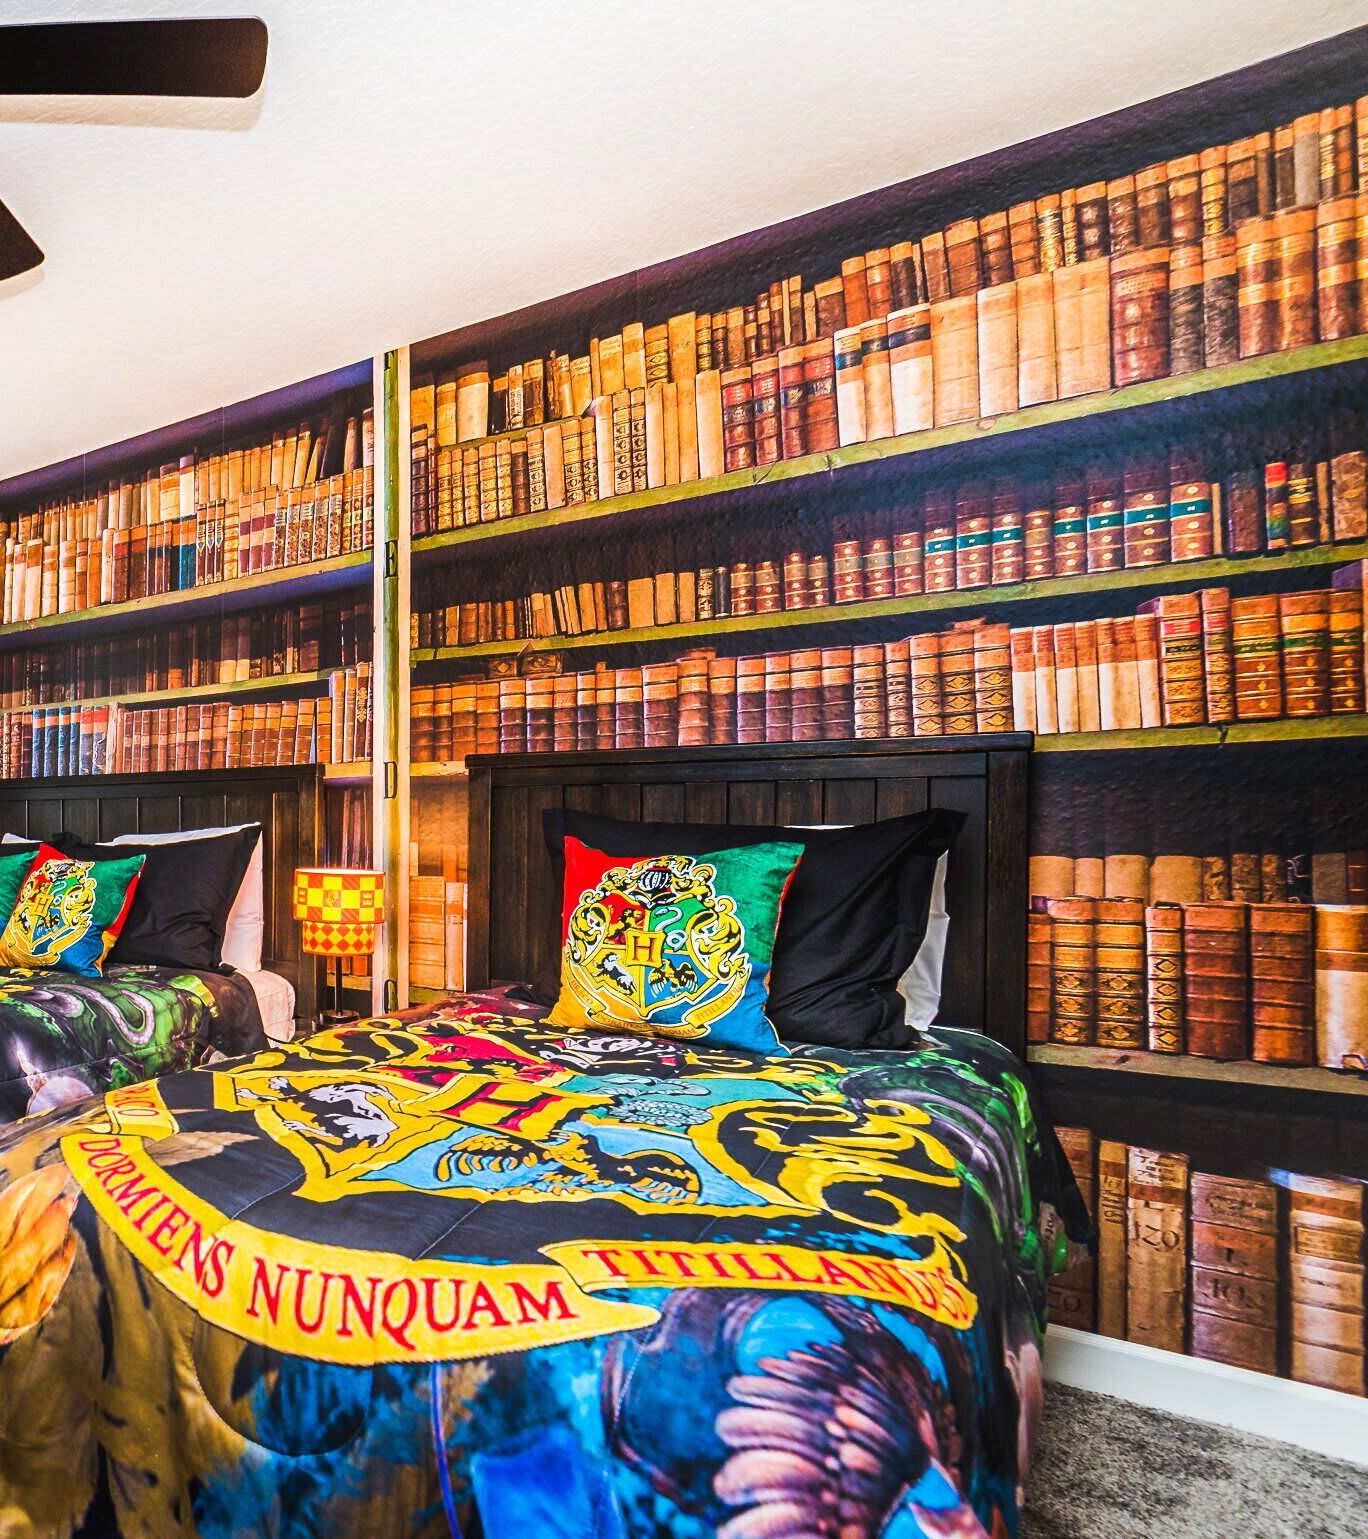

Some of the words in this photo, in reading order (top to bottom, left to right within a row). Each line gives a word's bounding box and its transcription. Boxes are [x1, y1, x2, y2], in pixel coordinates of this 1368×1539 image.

[385, 540, 398, 578] E
[384, 761, 399, 799] D
[632, 935, 657, 962] H
[436, 1082, 562, 1132] H
[79, 1137, 237, 1298] DORMIENS
[247, 1256, 580, 1353] NUNQUAM
[581, 1248, 969, 1321] TITILLANDUS
